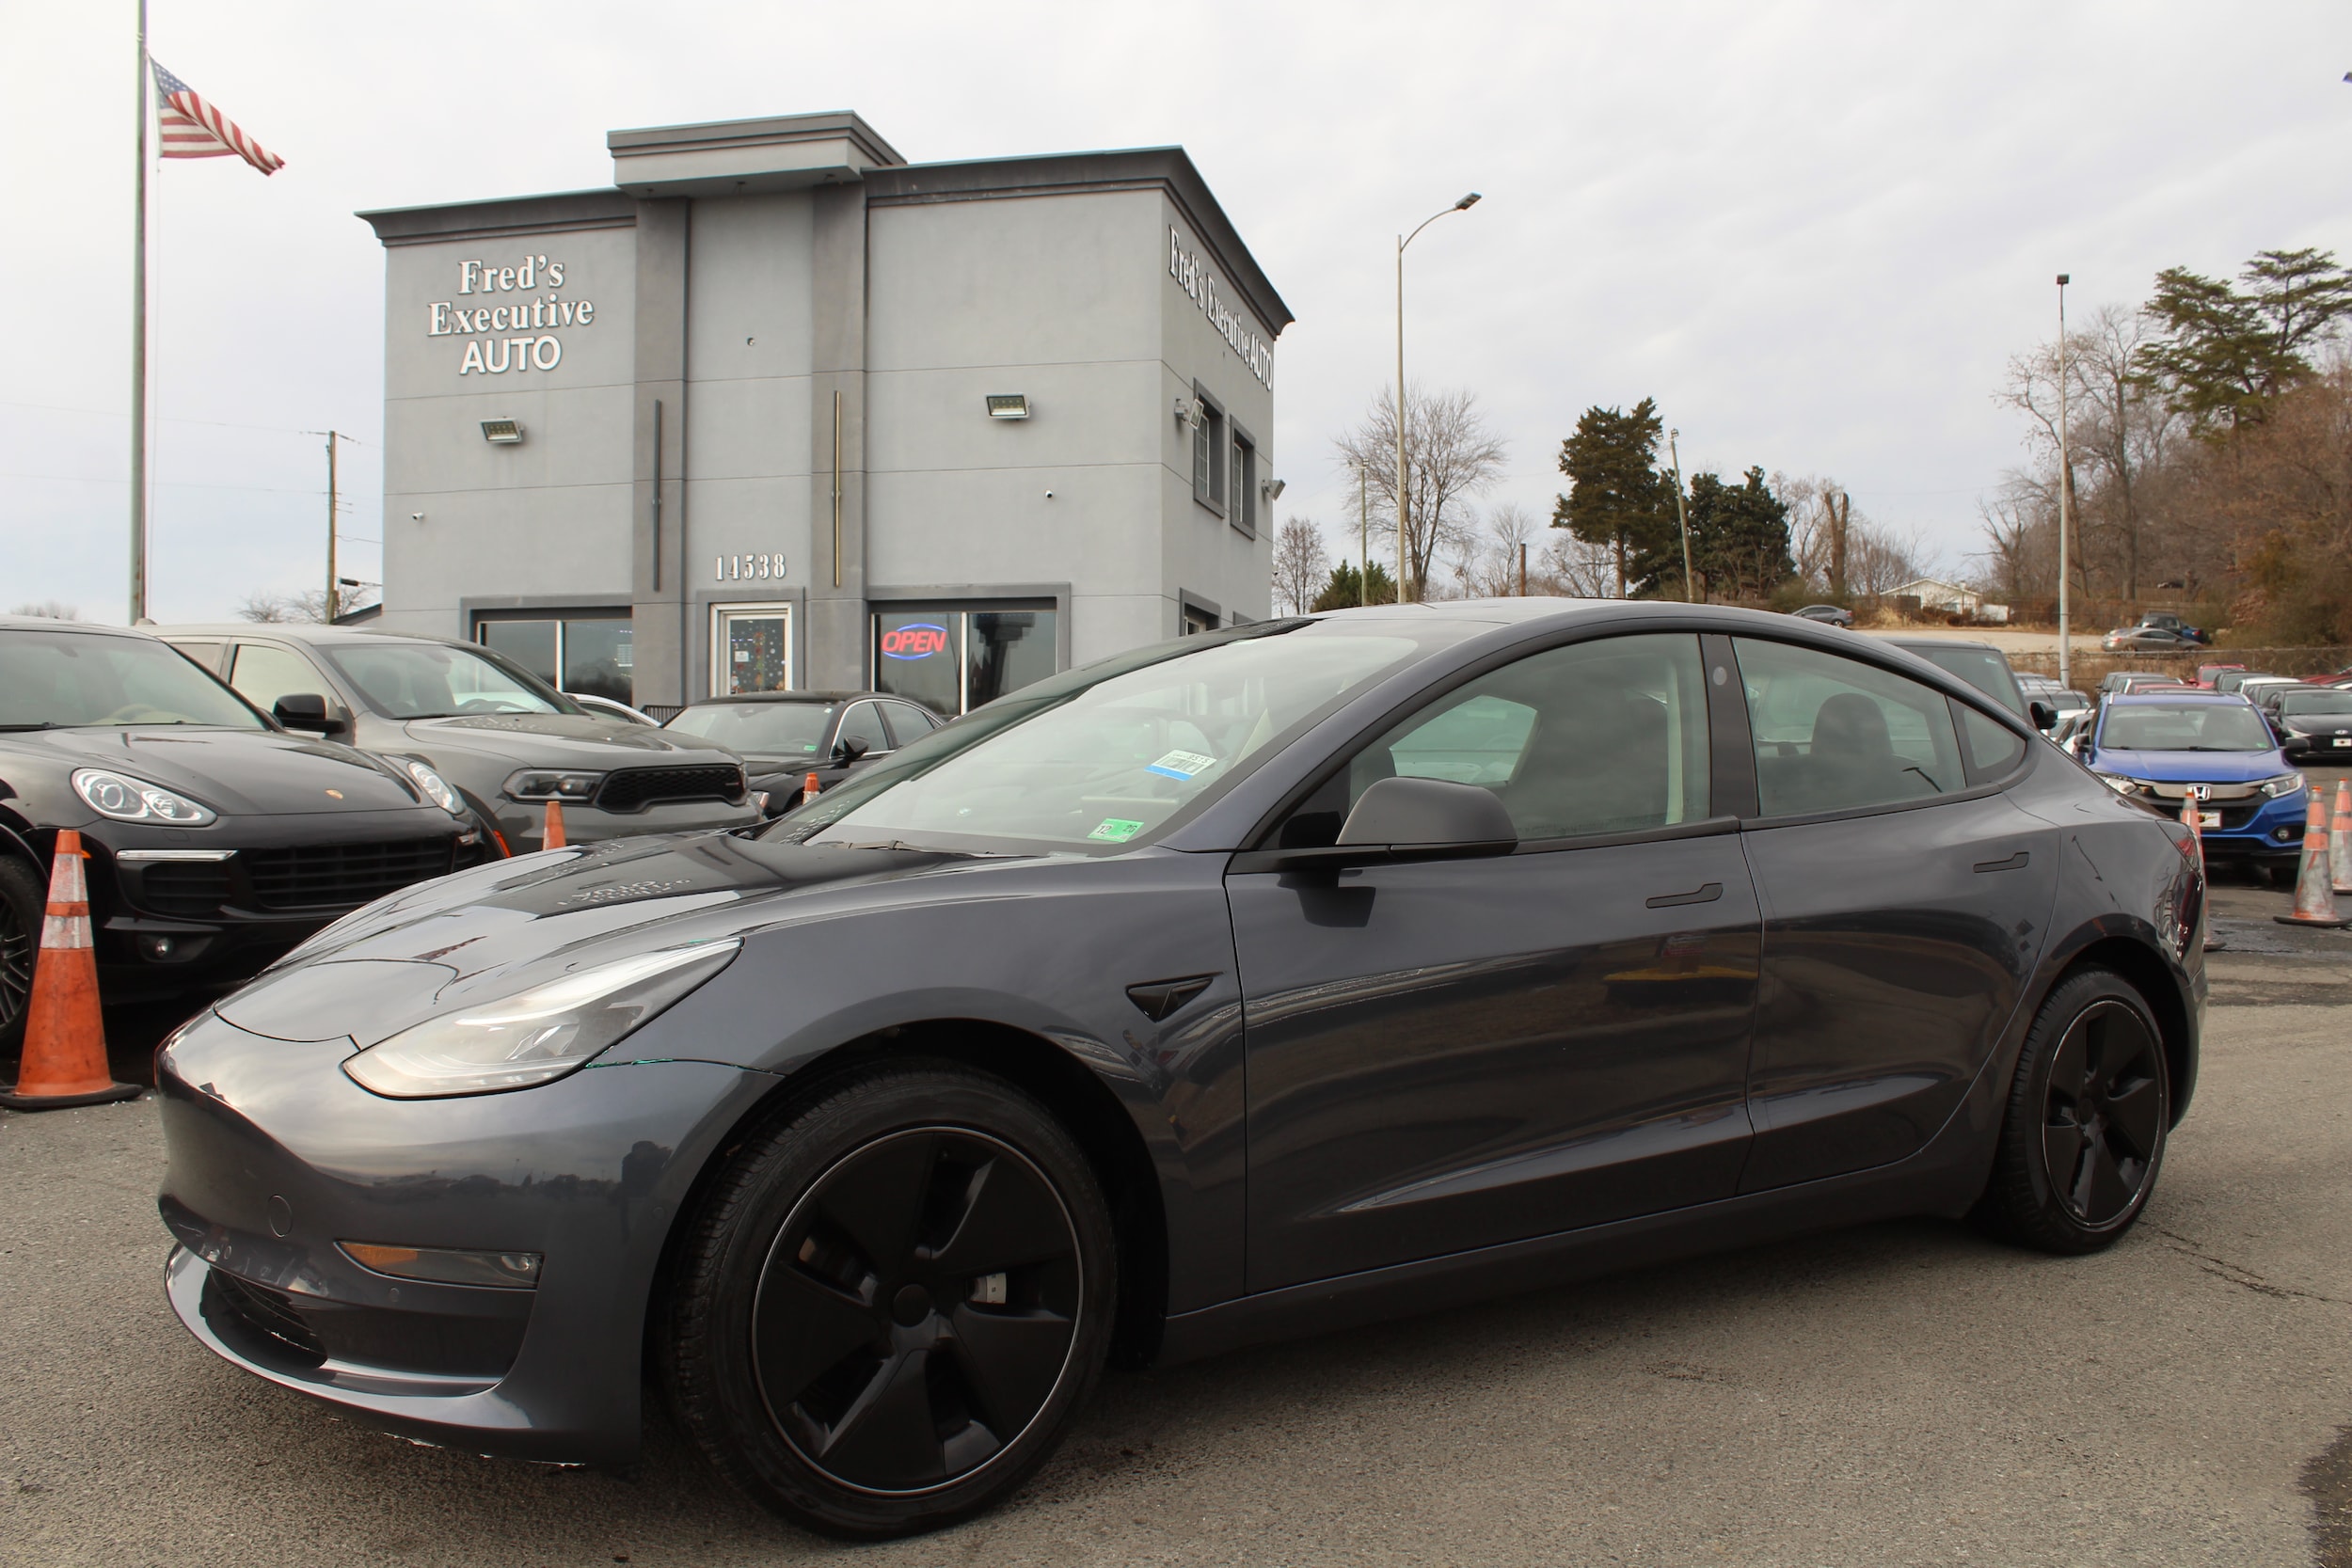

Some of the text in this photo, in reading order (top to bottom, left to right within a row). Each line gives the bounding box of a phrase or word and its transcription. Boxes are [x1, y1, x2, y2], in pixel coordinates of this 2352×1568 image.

[458, 255, 565, 294] Fred's
[427, 293, 595, 336] Executive
[1168, 225, 1273, 391] Fred's Executive AUTO
[459, 335, 563, 375] AUTO
[715, 553, 786, 580] 14538
[881, 631, 946, 653] OPEN
[1096, 825, 1113, 835] 12
